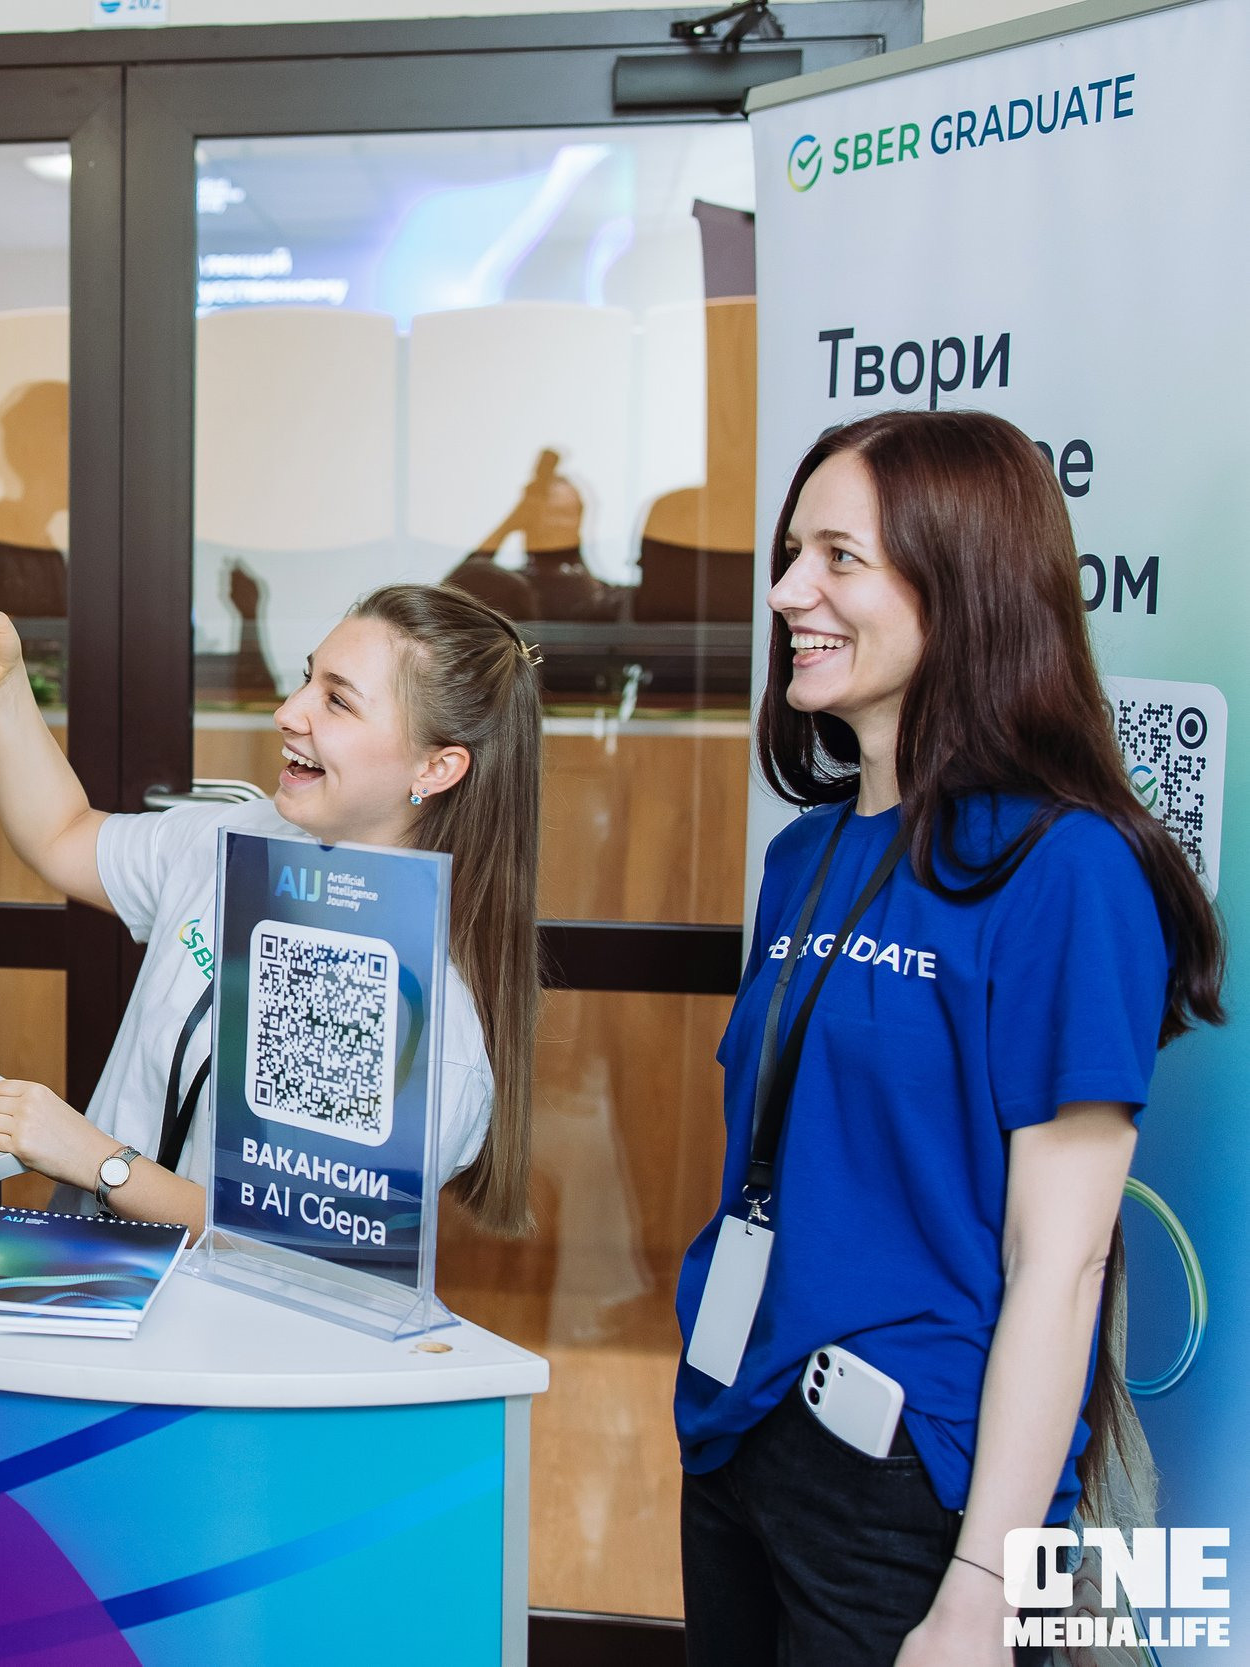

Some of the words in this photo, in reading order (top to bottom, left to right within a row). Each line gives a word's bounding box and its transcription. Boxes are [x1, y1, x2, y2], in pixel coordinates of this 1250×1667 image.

[831, 122, 921, 175] SBER
[930, 73, 1136, 156] GRADUATE
[818, 327, 1011, 410] Твори
[274, 865, 322, 902] AIJ
[326, 895, 361, 912] Journey
[327, 872, 365, 887] Artificial
[327, 883, 379, 901] Intelligence
[242, 1137, 389, 1201] ВАКАНСИИ
[240, 1182, 255, 1206] в
[261, 1182, 290, 1217] AI
[299, 1192, 386, 1246] Сбера
